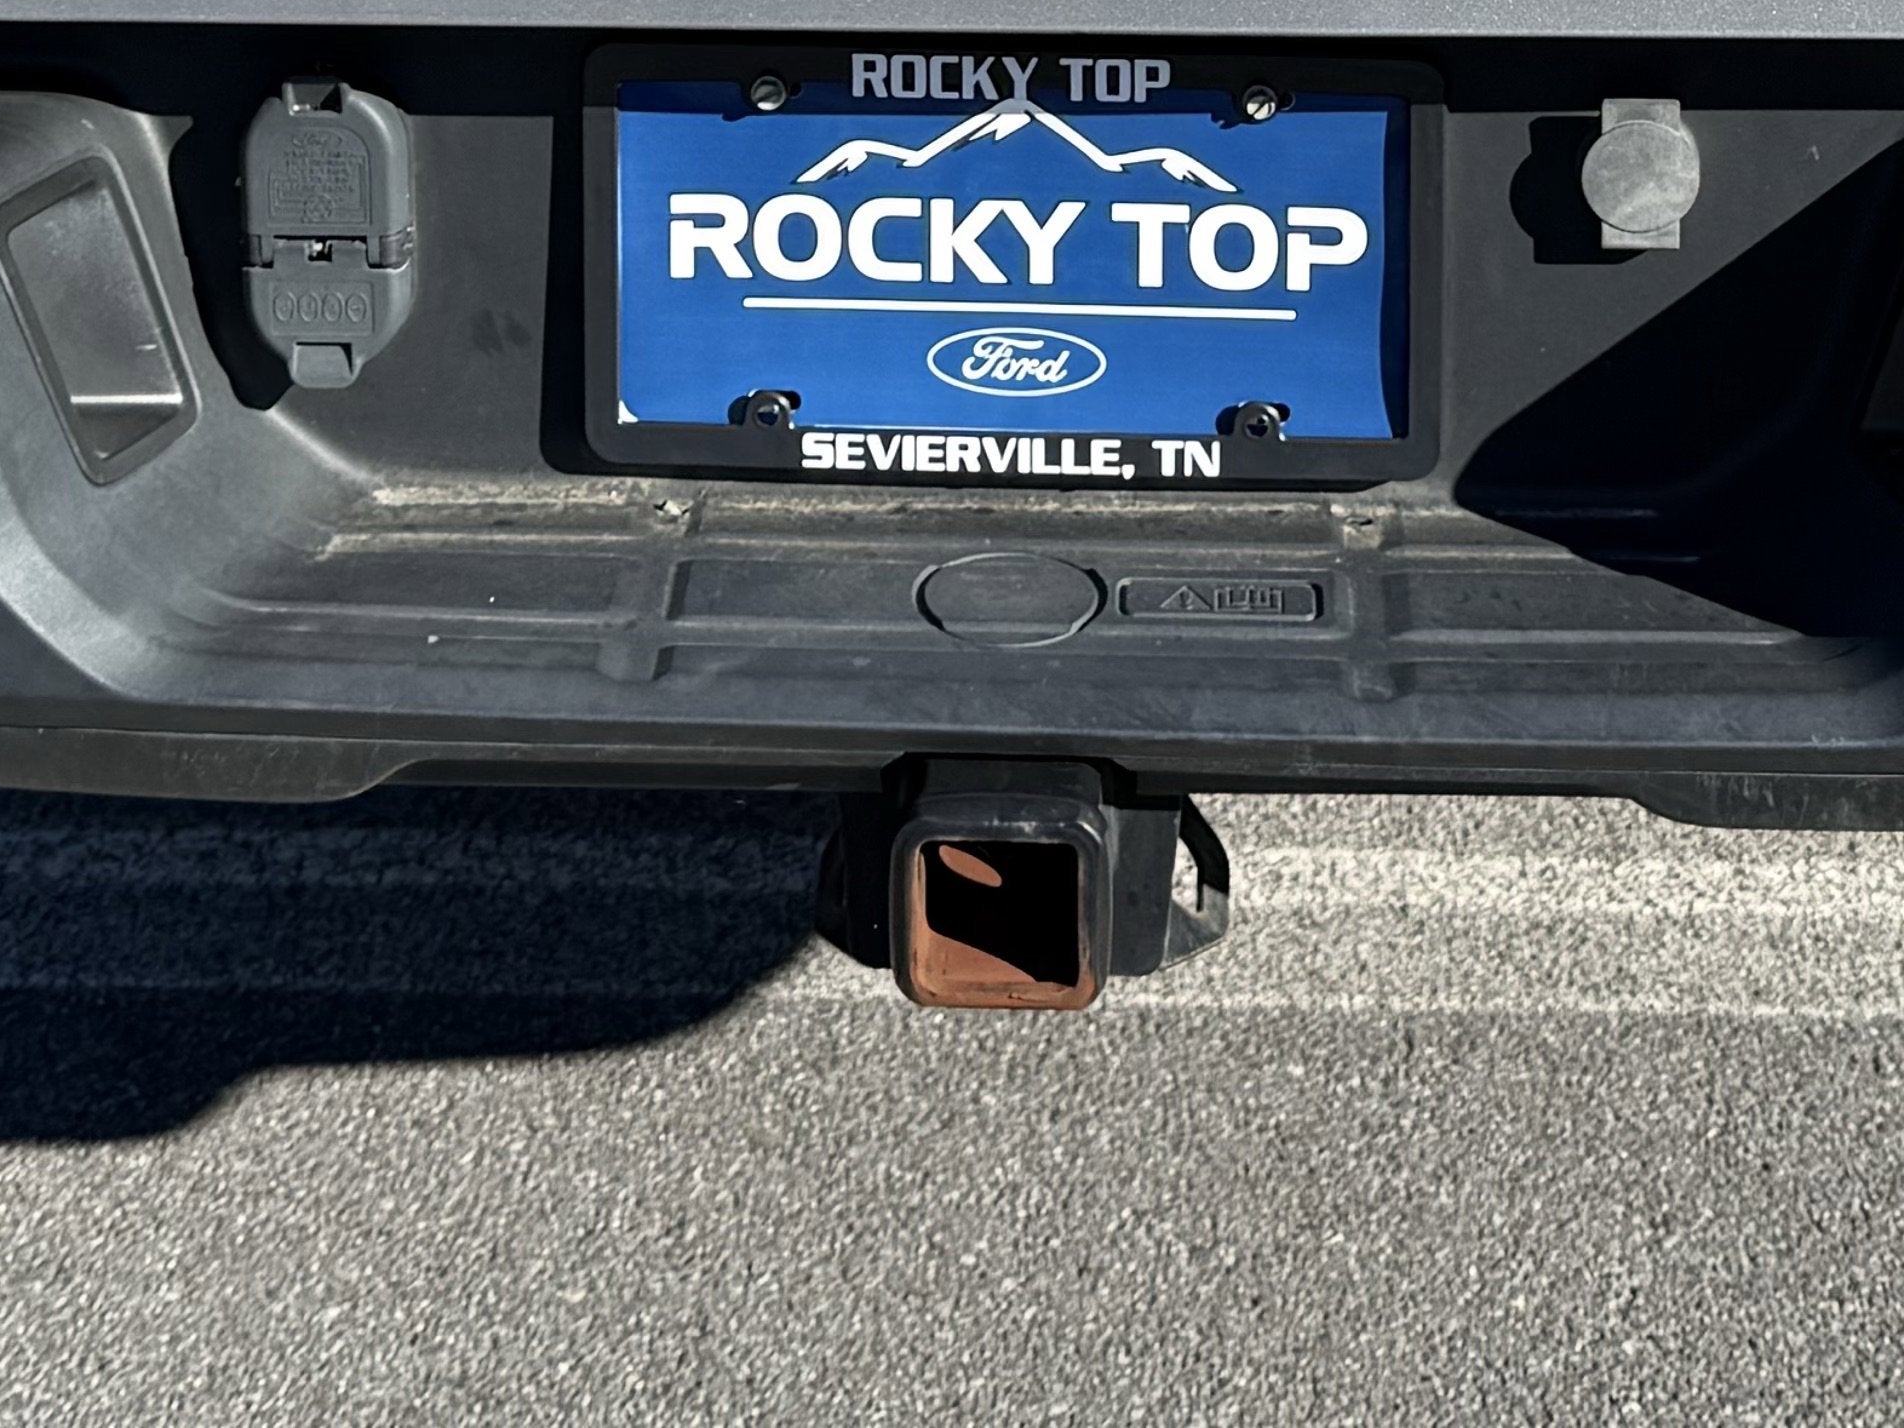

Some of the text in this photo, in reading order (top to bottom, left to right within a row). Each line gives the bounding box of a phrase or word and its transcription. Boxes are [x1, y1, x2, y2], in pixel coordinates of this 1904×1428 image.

[851, 52, 1171, 103] ROCKY TOP
[668, 192, 1369, 293] ROCKY TOP
[961, 336, 1071, 385] Ford
[800, 430, 1222, 480] SEVIERVILLE, TN
